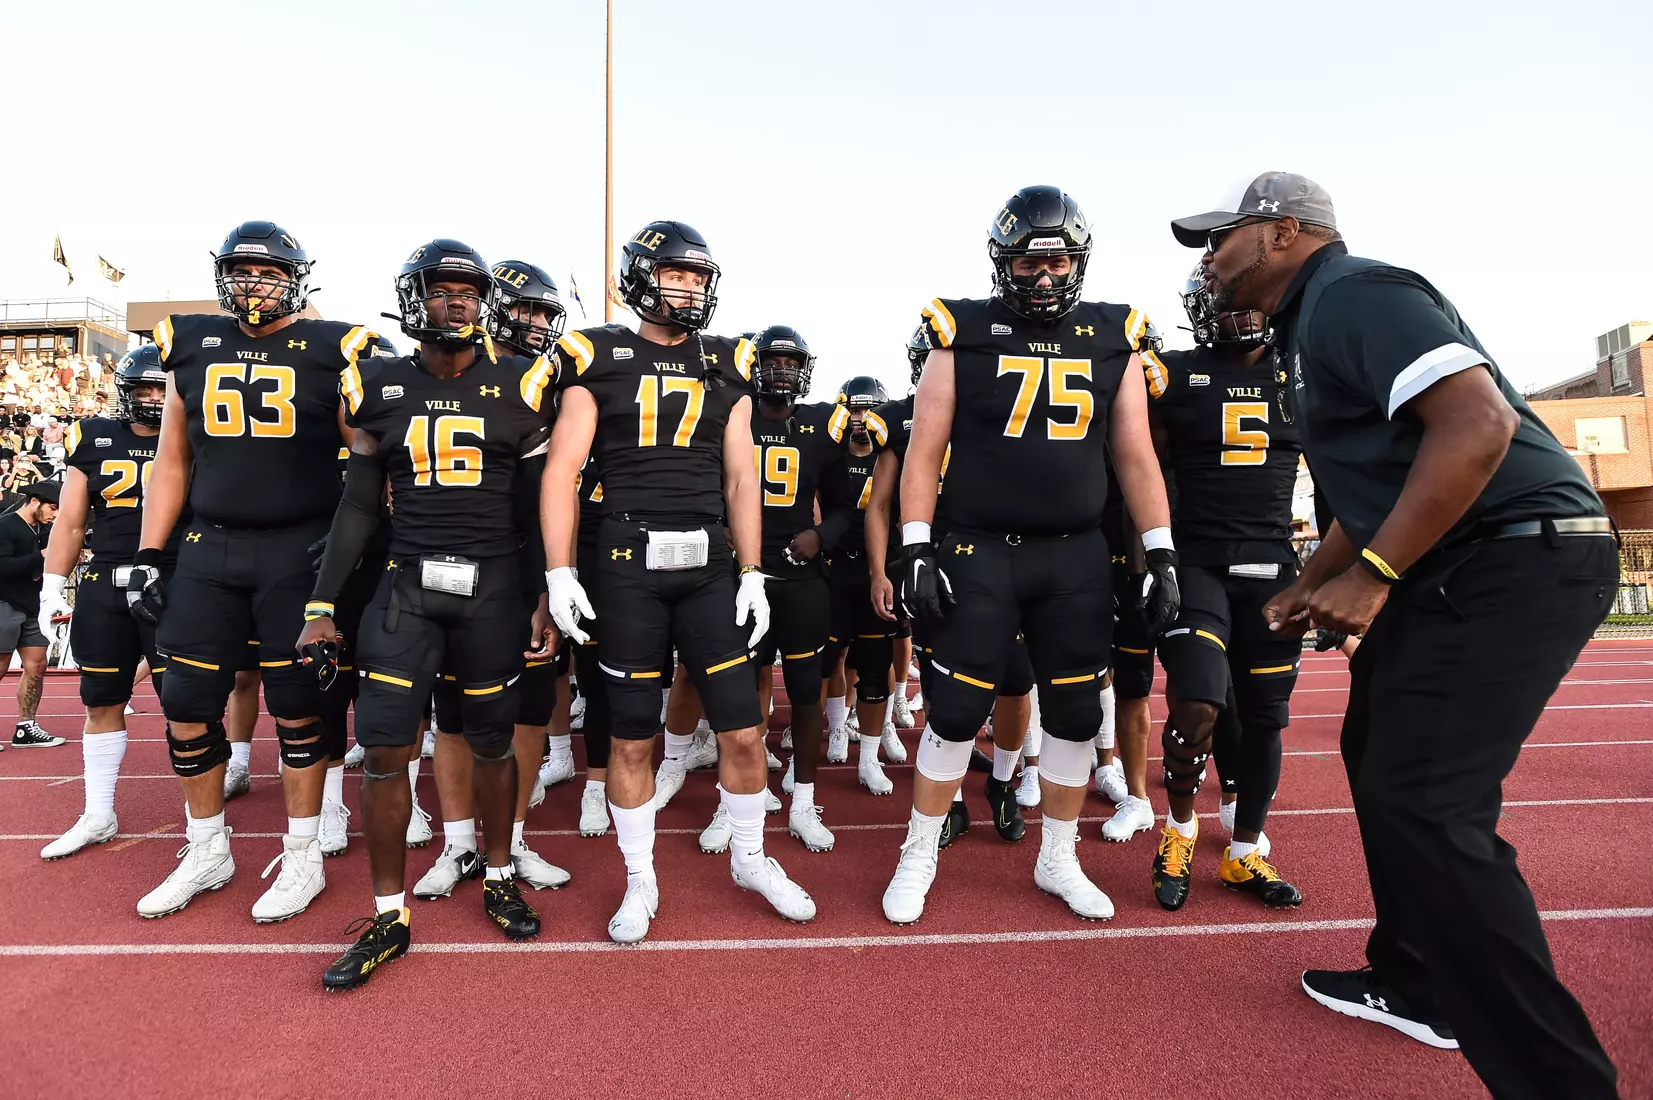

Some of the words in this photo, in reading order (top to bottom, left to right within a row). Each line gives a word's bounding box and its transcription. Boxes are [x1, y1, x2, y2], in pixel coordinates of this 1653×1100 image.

[1033, 239, 1062, 247] Riddell
[1028, 342, 1062, 354] VILLE
[236, 350, 268, 362] VILLE
[653, 362, 686, 374] VILLE
[997, 354, 1094, 441] 75
[1227, 387, 1262, 399] VILLE
[203, 362, 297, 438] 63
[425, 400, 461, 413] VILLE
[635, 374, 706, 449] 17
[1220, 402, 1270, 465] 5
[760, 435, 786, 445] VILLE
[128, 449, 155, 458] VILLE
[403, 415, 485, 488] 16
